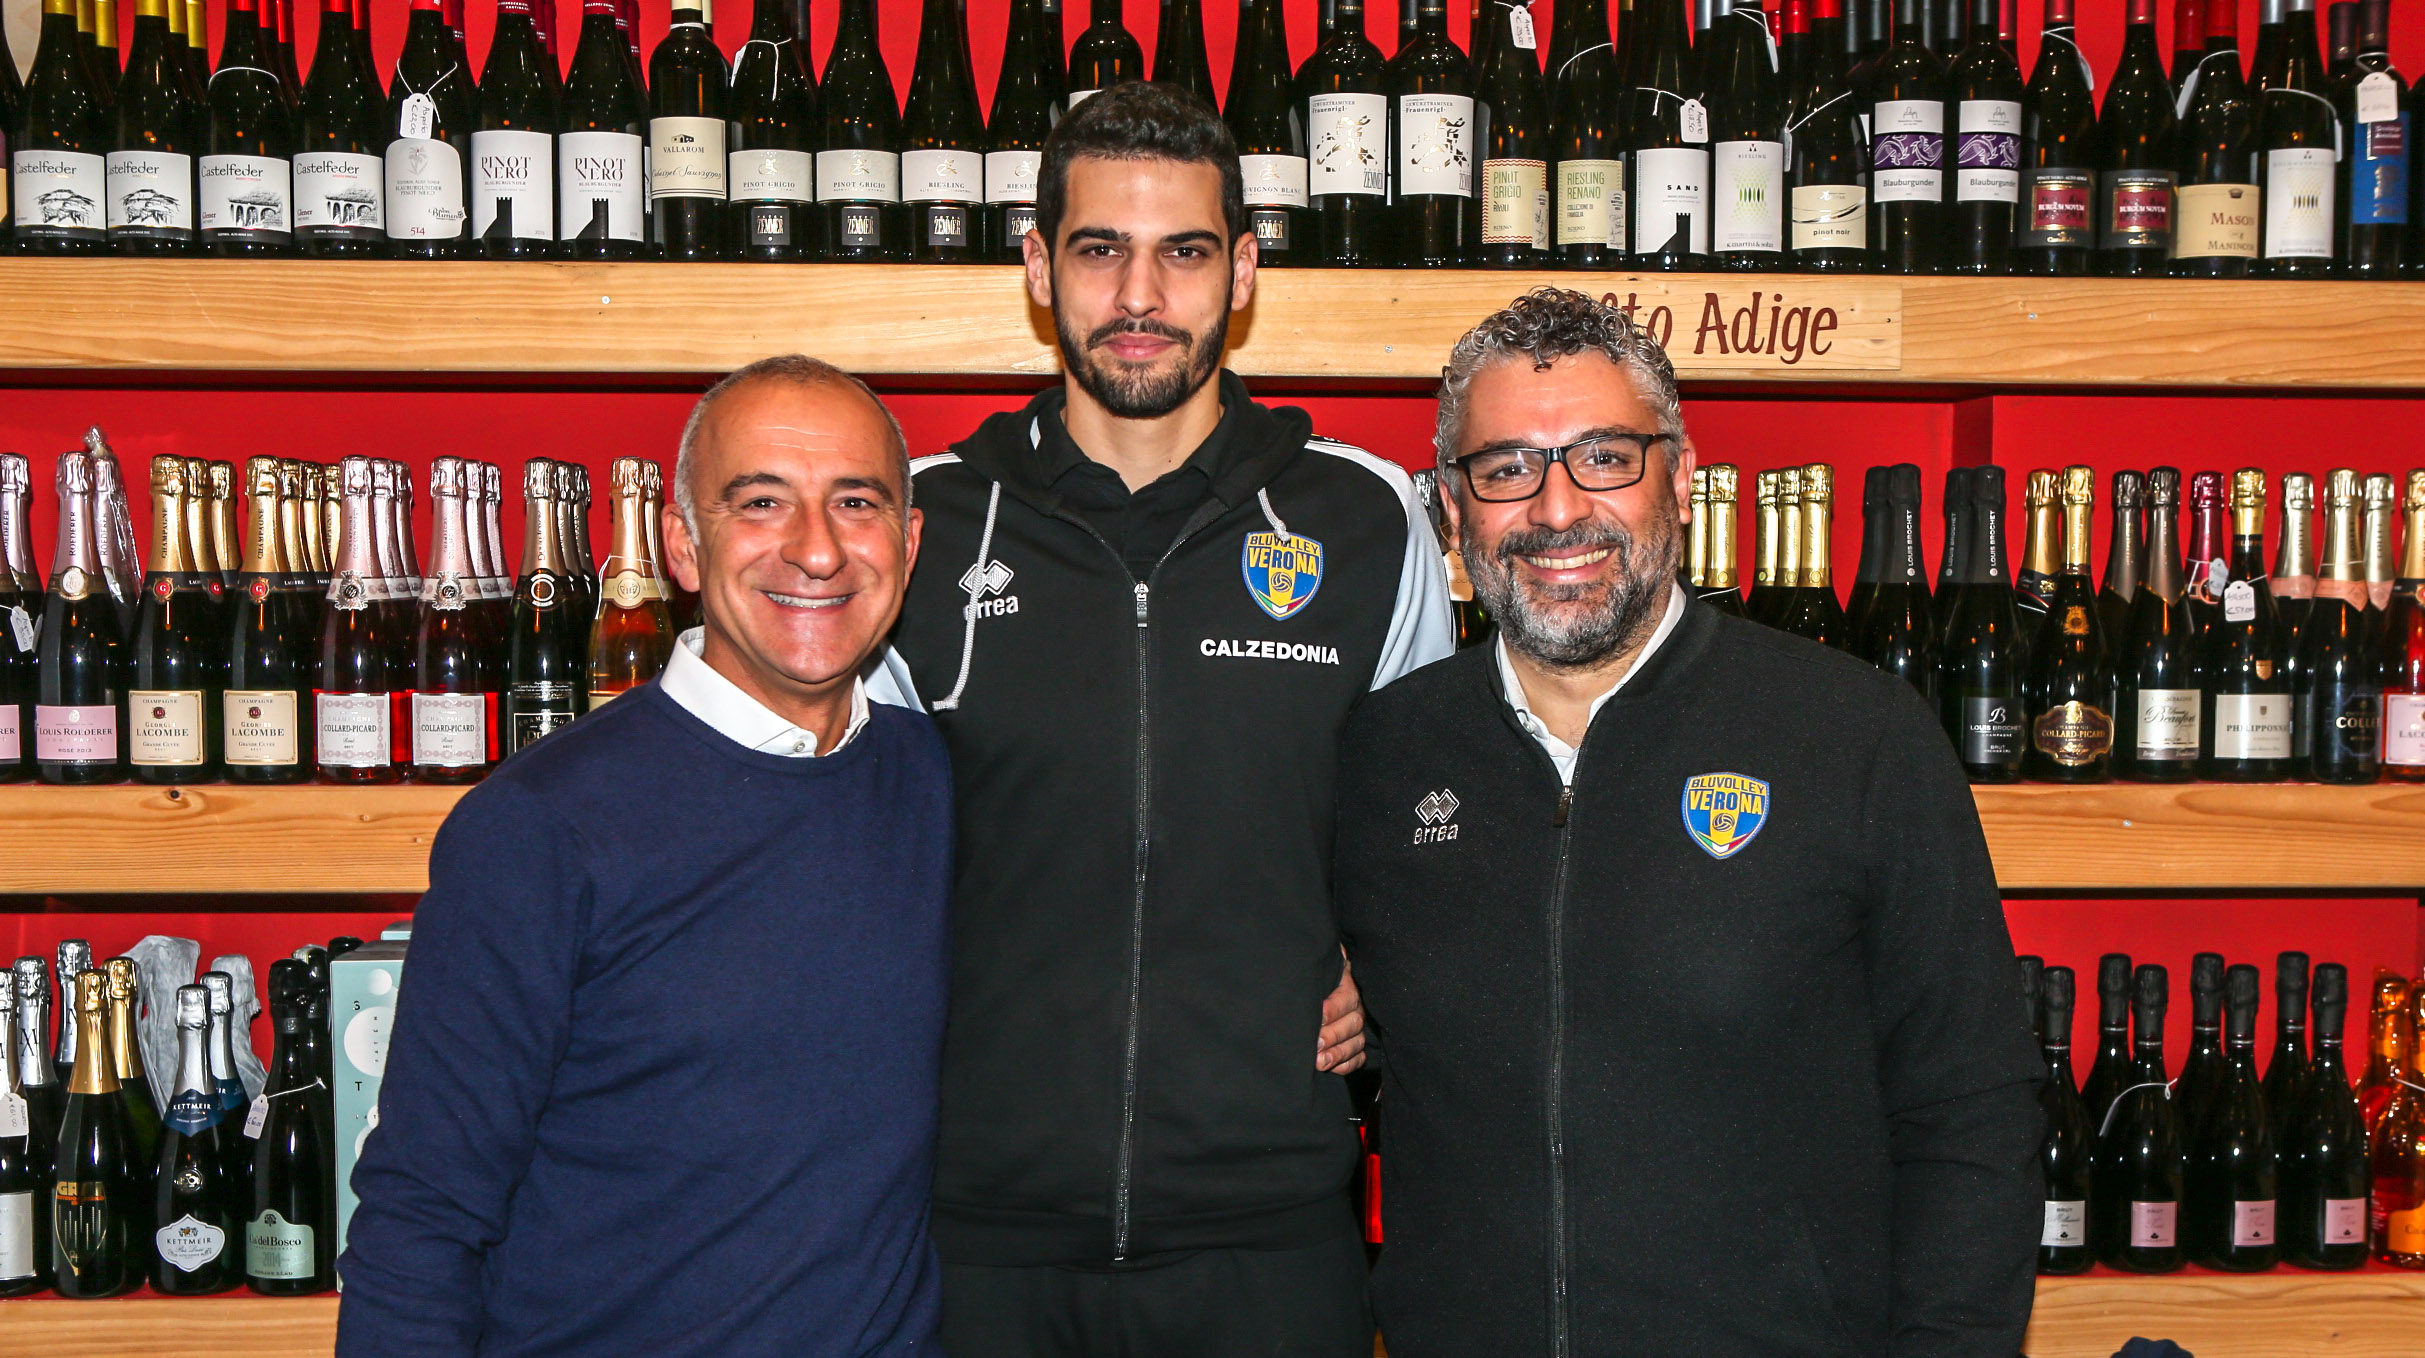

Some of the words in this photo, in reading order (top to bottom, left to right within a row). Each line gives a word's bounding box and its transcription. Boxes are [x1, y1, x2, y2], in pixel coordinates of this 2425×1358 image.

[297, 161, 360, 175] Castelfeder
[481, 156, 532, 169] PINOT
[575, 158, 626, 170] PINOT
[202, 164, 264, 178] Castelfeder
[482, 167, 528, 179] NERO
[576, 168, 624, 181] NERO
[1493, 171, 1519, 184] PINOT
[1567, 172, 1605, 185] RIESLING
[1883, 178, 1935, 188] Blauburgunder
[1493, 186, 1521, 199] GRIGIO
[1567, 187, 1601, 199] RENANO
[410, 227, 425, 236] 514
[1693, 291, 1838, 365] Adige
[257, 508, 265, 560] CHAMPAGNE
[1250, 535, 1319, 554] BLUVLLEY
[1248, 547, 1319, 577] VERONA
[1200, 638, 1341, 666] CALZEDONIA
[136, 728, 189, 737] LACOMBE
[232, 728, 284, 737] LACOMBE
[324, 725, 377, 733] COLLARD-PICARD
[421, 724, 475, 733] COLLARD-PICARD
[2042, 730, 2105, 738] COLLARD-PICARD
[1691, 777, 1766, 794] BLUVOLLEY
[1689, 789, 1764, 815] VERONA
[271, 1237, 302, 1246] Bosco
